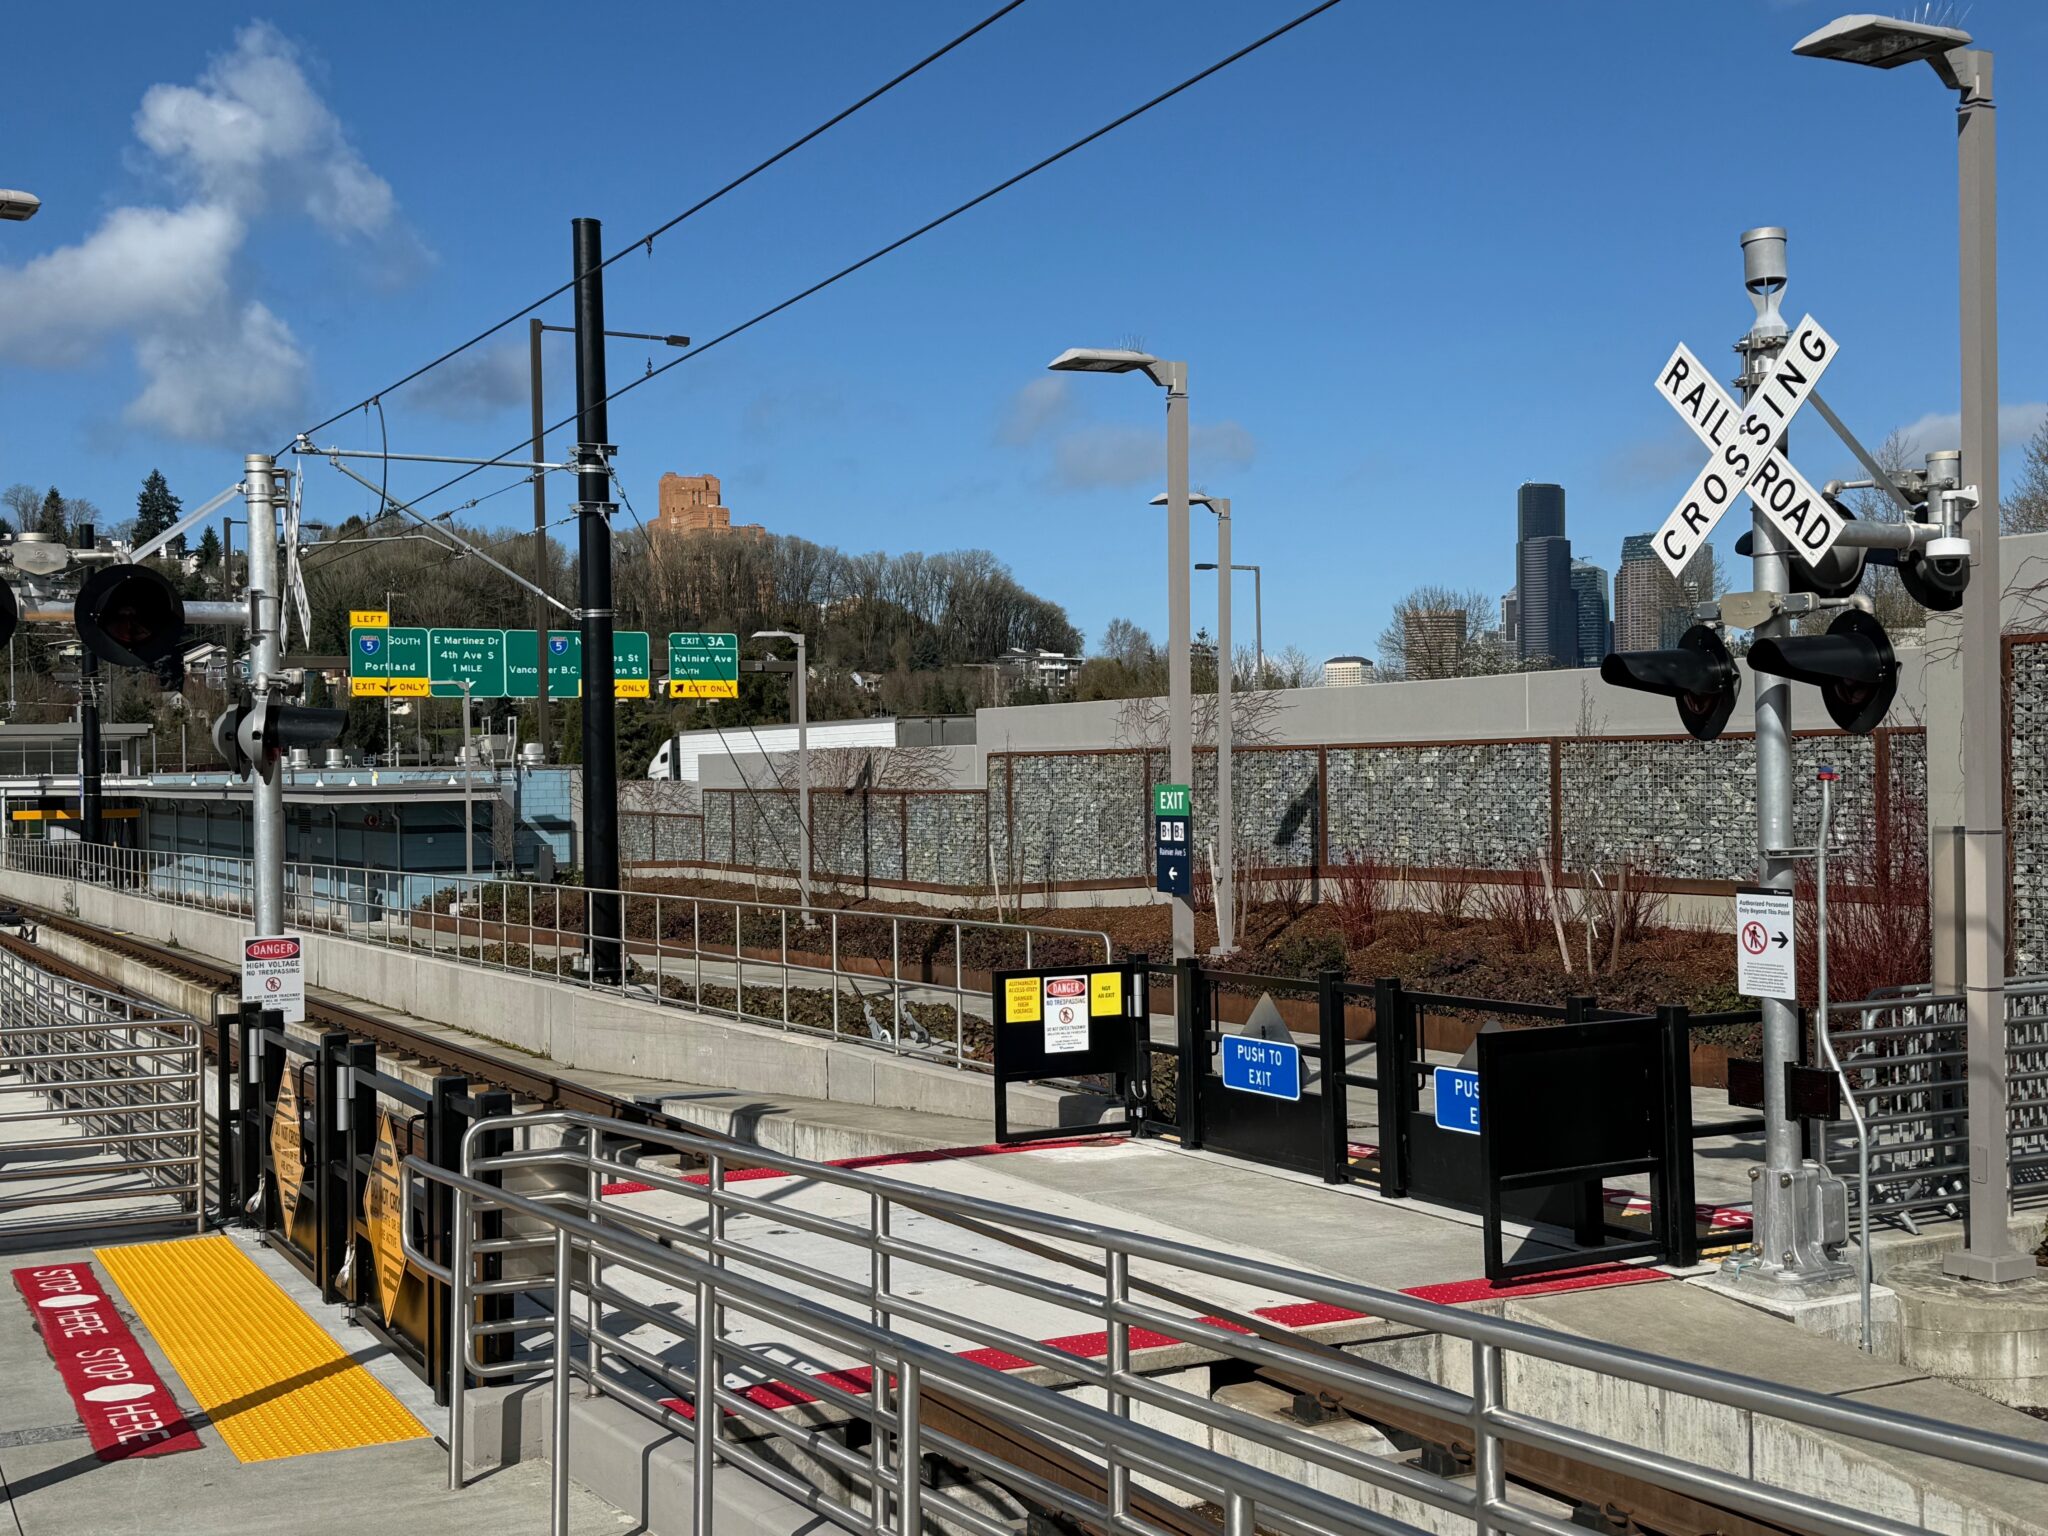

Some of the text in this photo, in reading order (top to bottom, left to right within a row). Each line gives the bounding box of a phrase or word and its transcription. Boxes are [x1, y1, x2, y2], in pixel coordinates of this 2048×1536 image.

[1663, 330, 1826, 560] CROSSING
[1664, 356, 1830, 550] RAIL ROAD
[366, 641, 373, 650] 5
[388, 636, 420, 645] SOUTH
[434, 636, 500, 645] E Martinez Dr
[556, 642, 562, 650] 5
[707, 636, 725, 646] 3A
[440, 651, 458, 659] 4th
[488, 651, 494, 659] S
[674, 654, 710, 662] Rainier
[365, 662, 416, 671] Portland
[453, 664, 457, 672] 1
[509, 666, 557, 674] Vancoer
[1160, 792, 1184, 810] EXIT
[254, 944, 293, 955] DANGER
[268, 960, 300, 968] VOLTAGE
[1053, 982, 1080, 993] DANGER
[1237, 1044, 1282, 1066] PUSH TO
[1249, 1068, 1271, 1087] EXIT
[1455, 1078, 1479, 1099] PUS
[32, 1269, 170, 1445] STOP HERE STOP HERE
